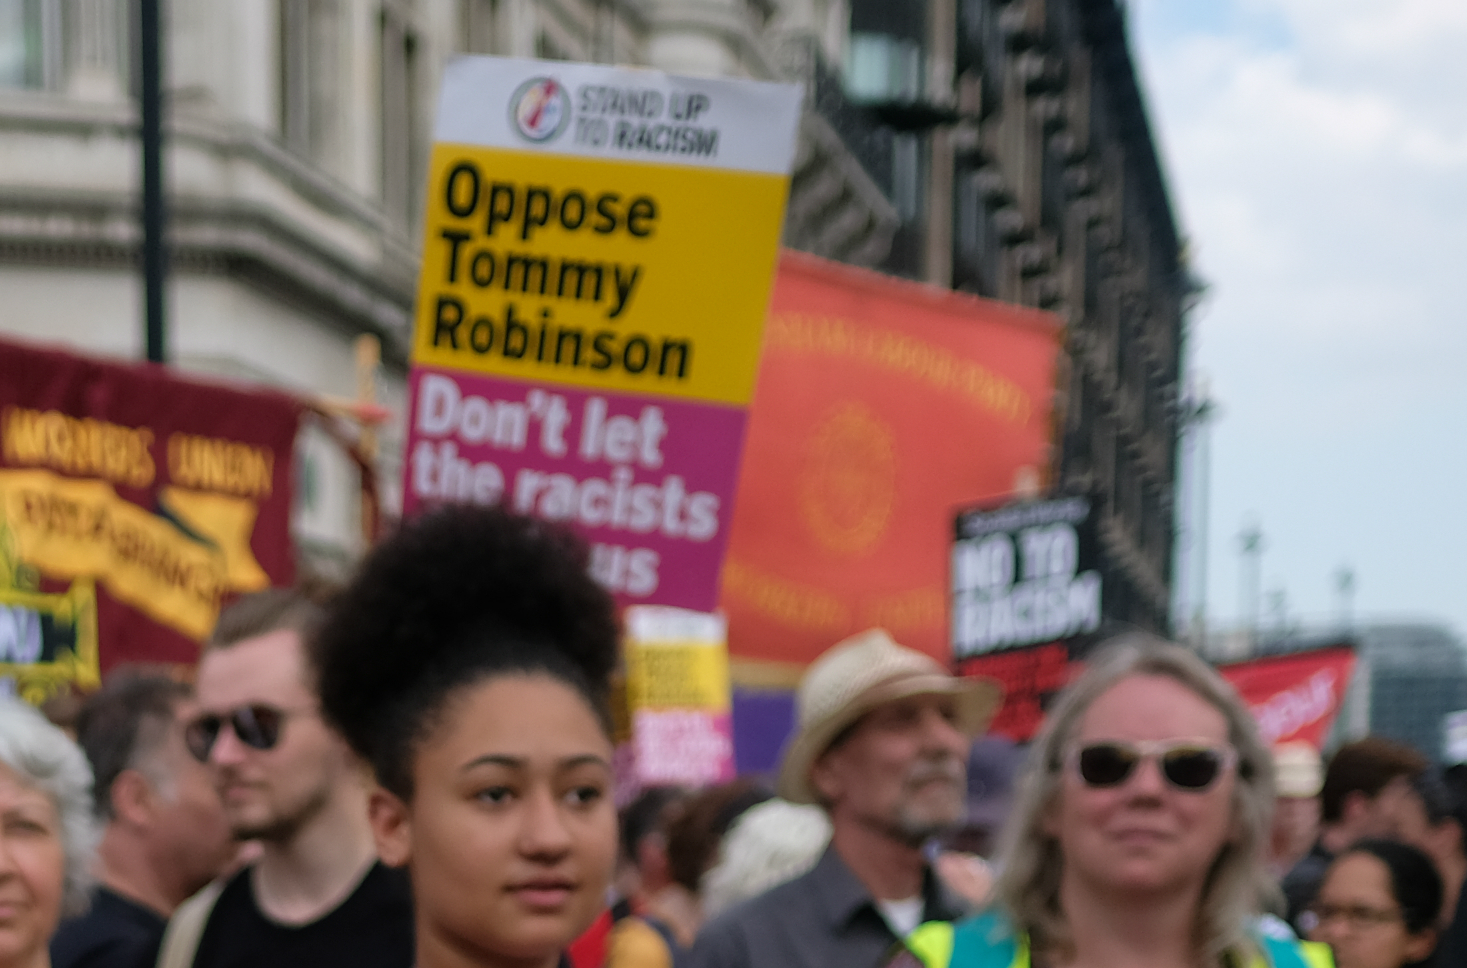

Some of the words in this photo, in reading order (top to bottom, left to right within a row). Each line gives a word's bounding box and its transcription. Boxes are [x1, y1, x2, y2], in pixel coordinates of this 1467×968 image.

[575, 116, 610, 147] TO
[612, 120, 720, 158] RACISM
[579, 85, 665, 119] STAND
[668, 92, 711, 122] UP
[444, 160, 660, 241] Oppose
[439, 228, 643, 319] Tommy
[432, 294, 693, 379] Robinson
[418, 374, 570, 457] Don't
[579, 396, 668, 468] let
[413, 441, 506, 506] the
[515, 467, 721, 541] racists
[587, 541, 660, 597] us
[953, 531, 1016, 592] NO
[1021, 521, 1079, 580] TO
[953, 569, 1103, 658] RACISM
